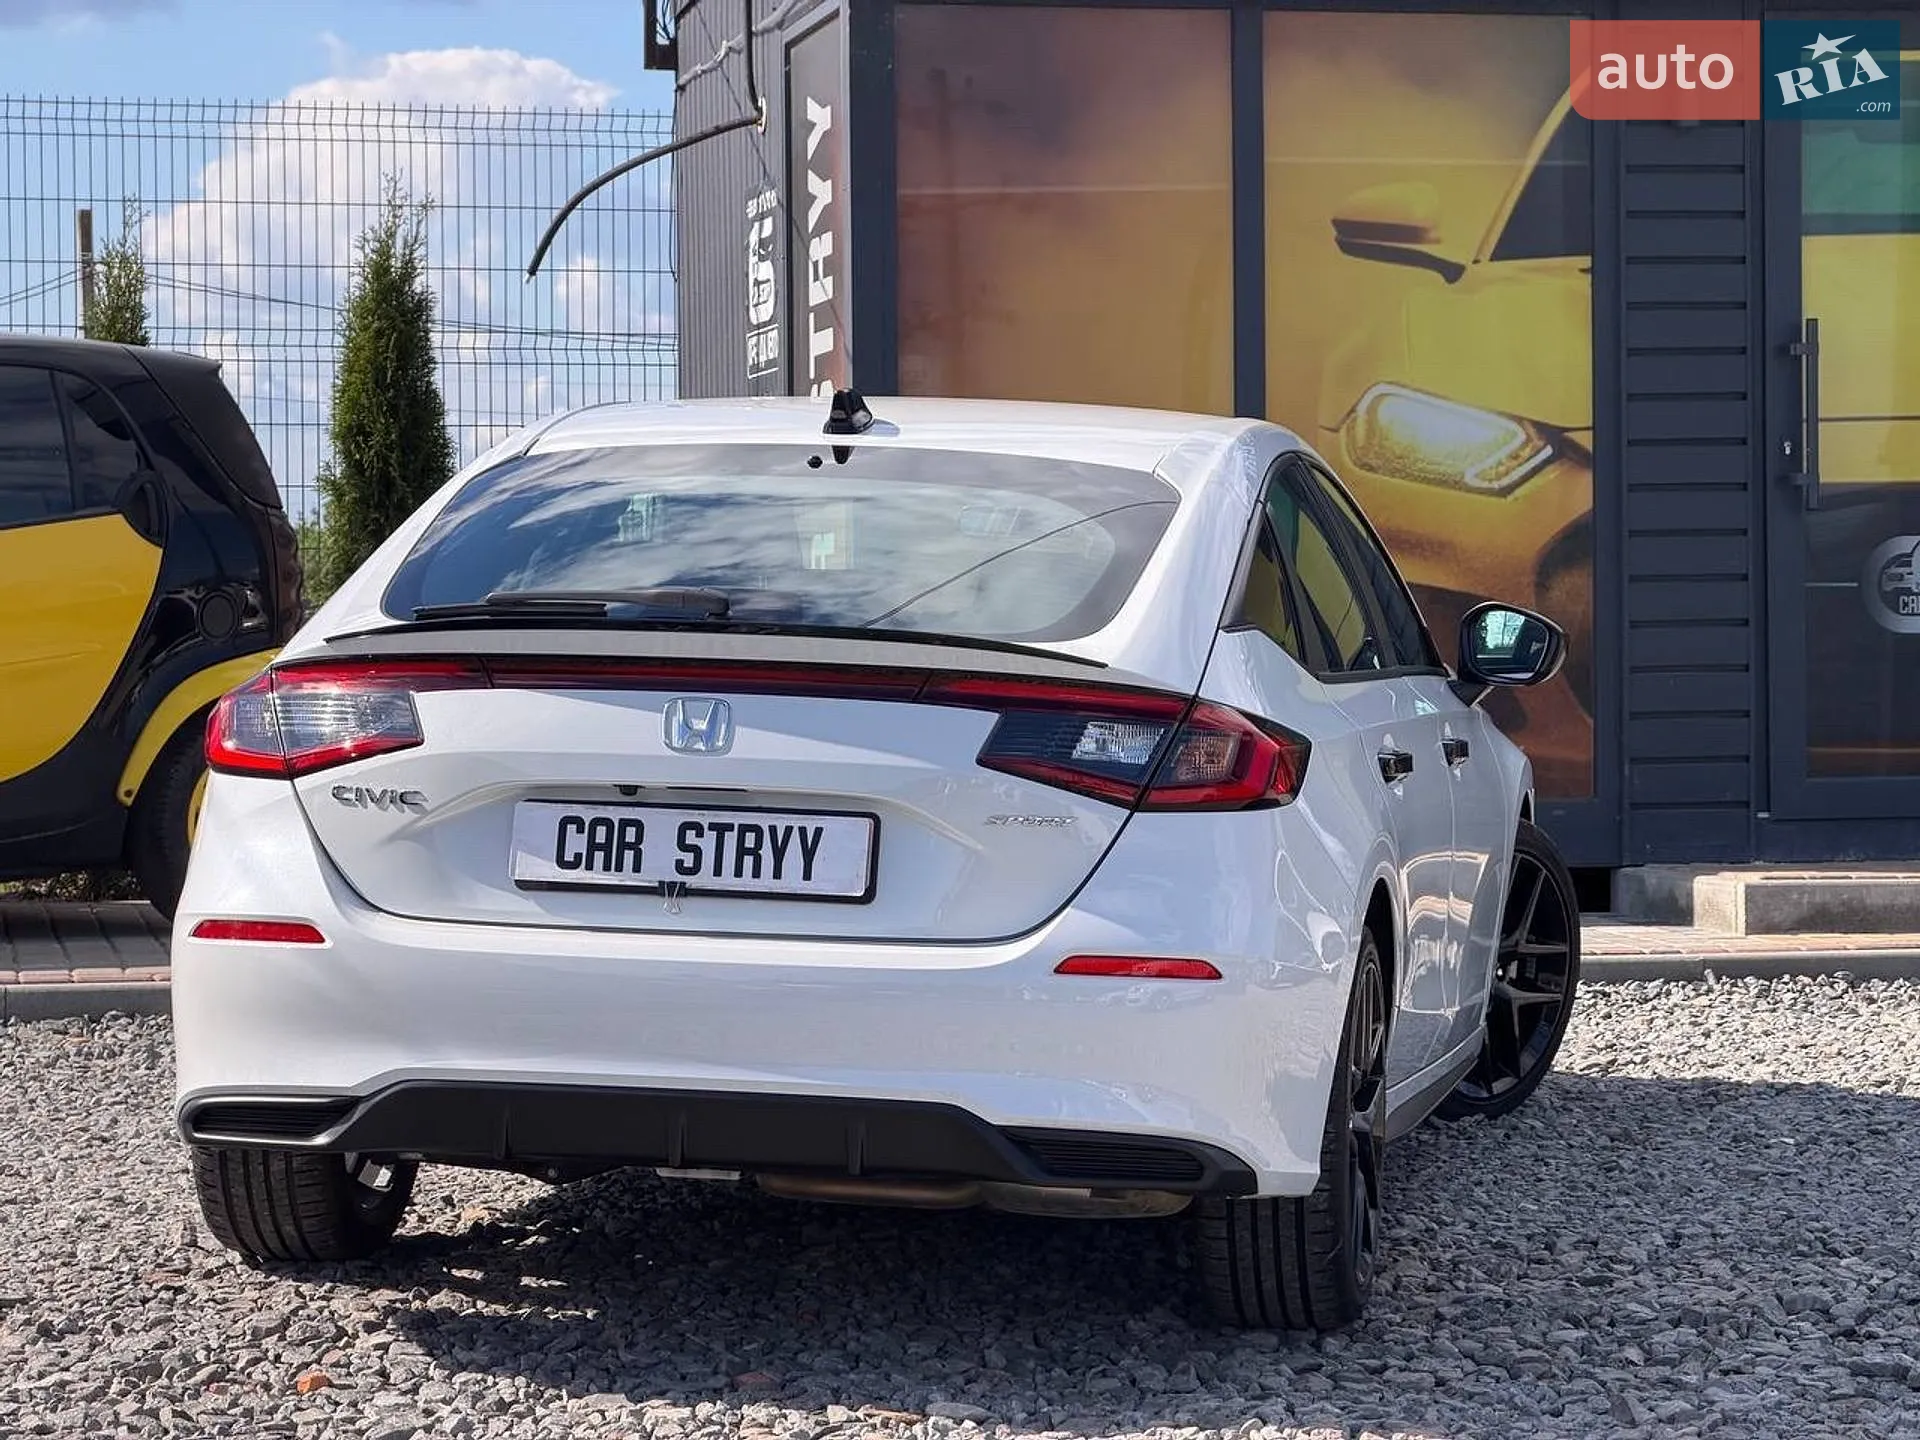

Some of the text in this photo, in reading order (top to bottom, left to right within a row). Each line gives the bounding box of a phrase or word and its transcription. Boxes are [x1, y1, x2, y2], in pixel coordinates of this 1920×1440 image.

[1899, 595, 1920, 614] CA
[331, 785, 430, 813] CIVIC
[555, 815, 824, 882] CAR STRYY
